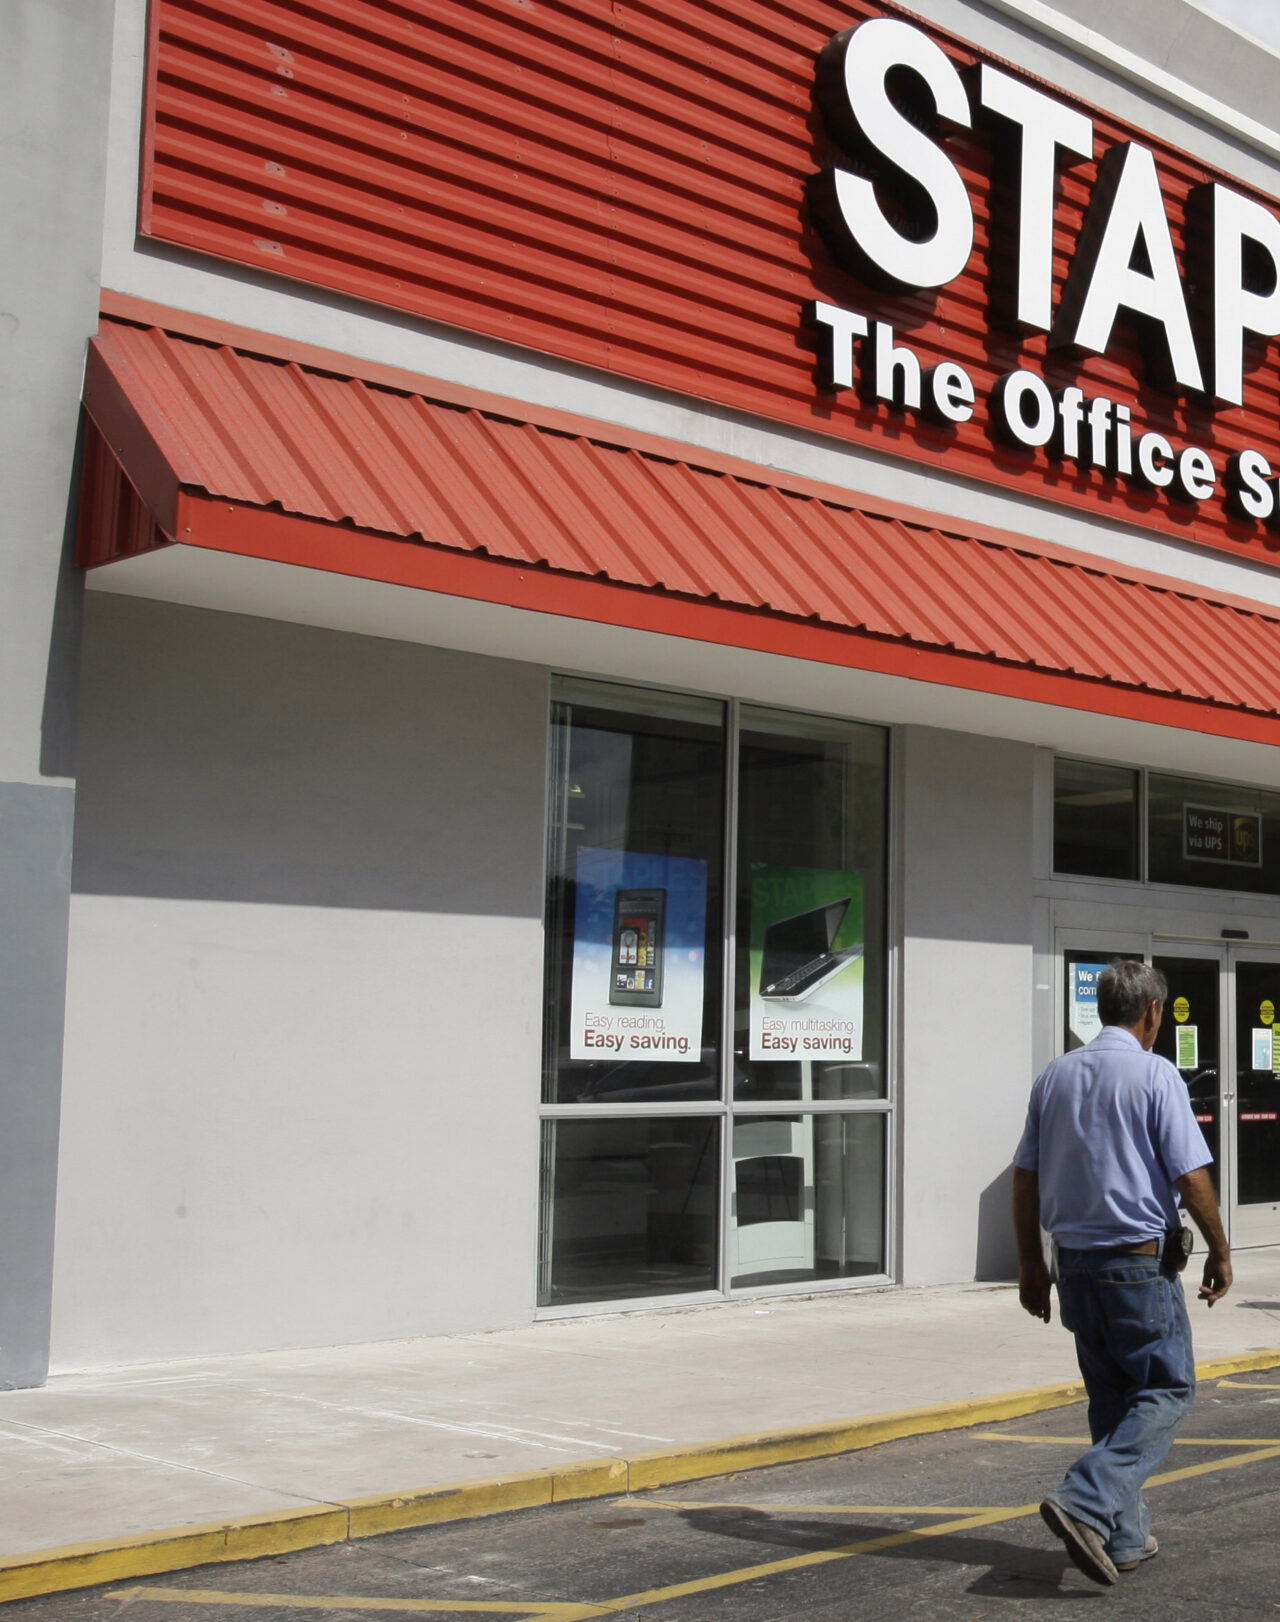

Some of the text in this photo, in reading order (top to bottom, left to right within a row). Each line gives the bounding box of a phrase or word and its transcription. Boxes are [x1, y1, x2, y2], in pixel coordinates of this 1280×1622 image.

[814, 300, 976, 423] The
[1004, 369, 1216, 500] Office
[1189, 815, 1223, 834] We ship
[1189, 834, 1223, 850] via UPS
[1078, 970, 1093, 982] We
[585, 1012, 665, 1033] Easy reading.
[762, 1016, 856, 1035] Easy multitasking.
[584, 1029, 691, 1054] Easy saving.
[761, 1032, 853, 1054] Easy saving.
